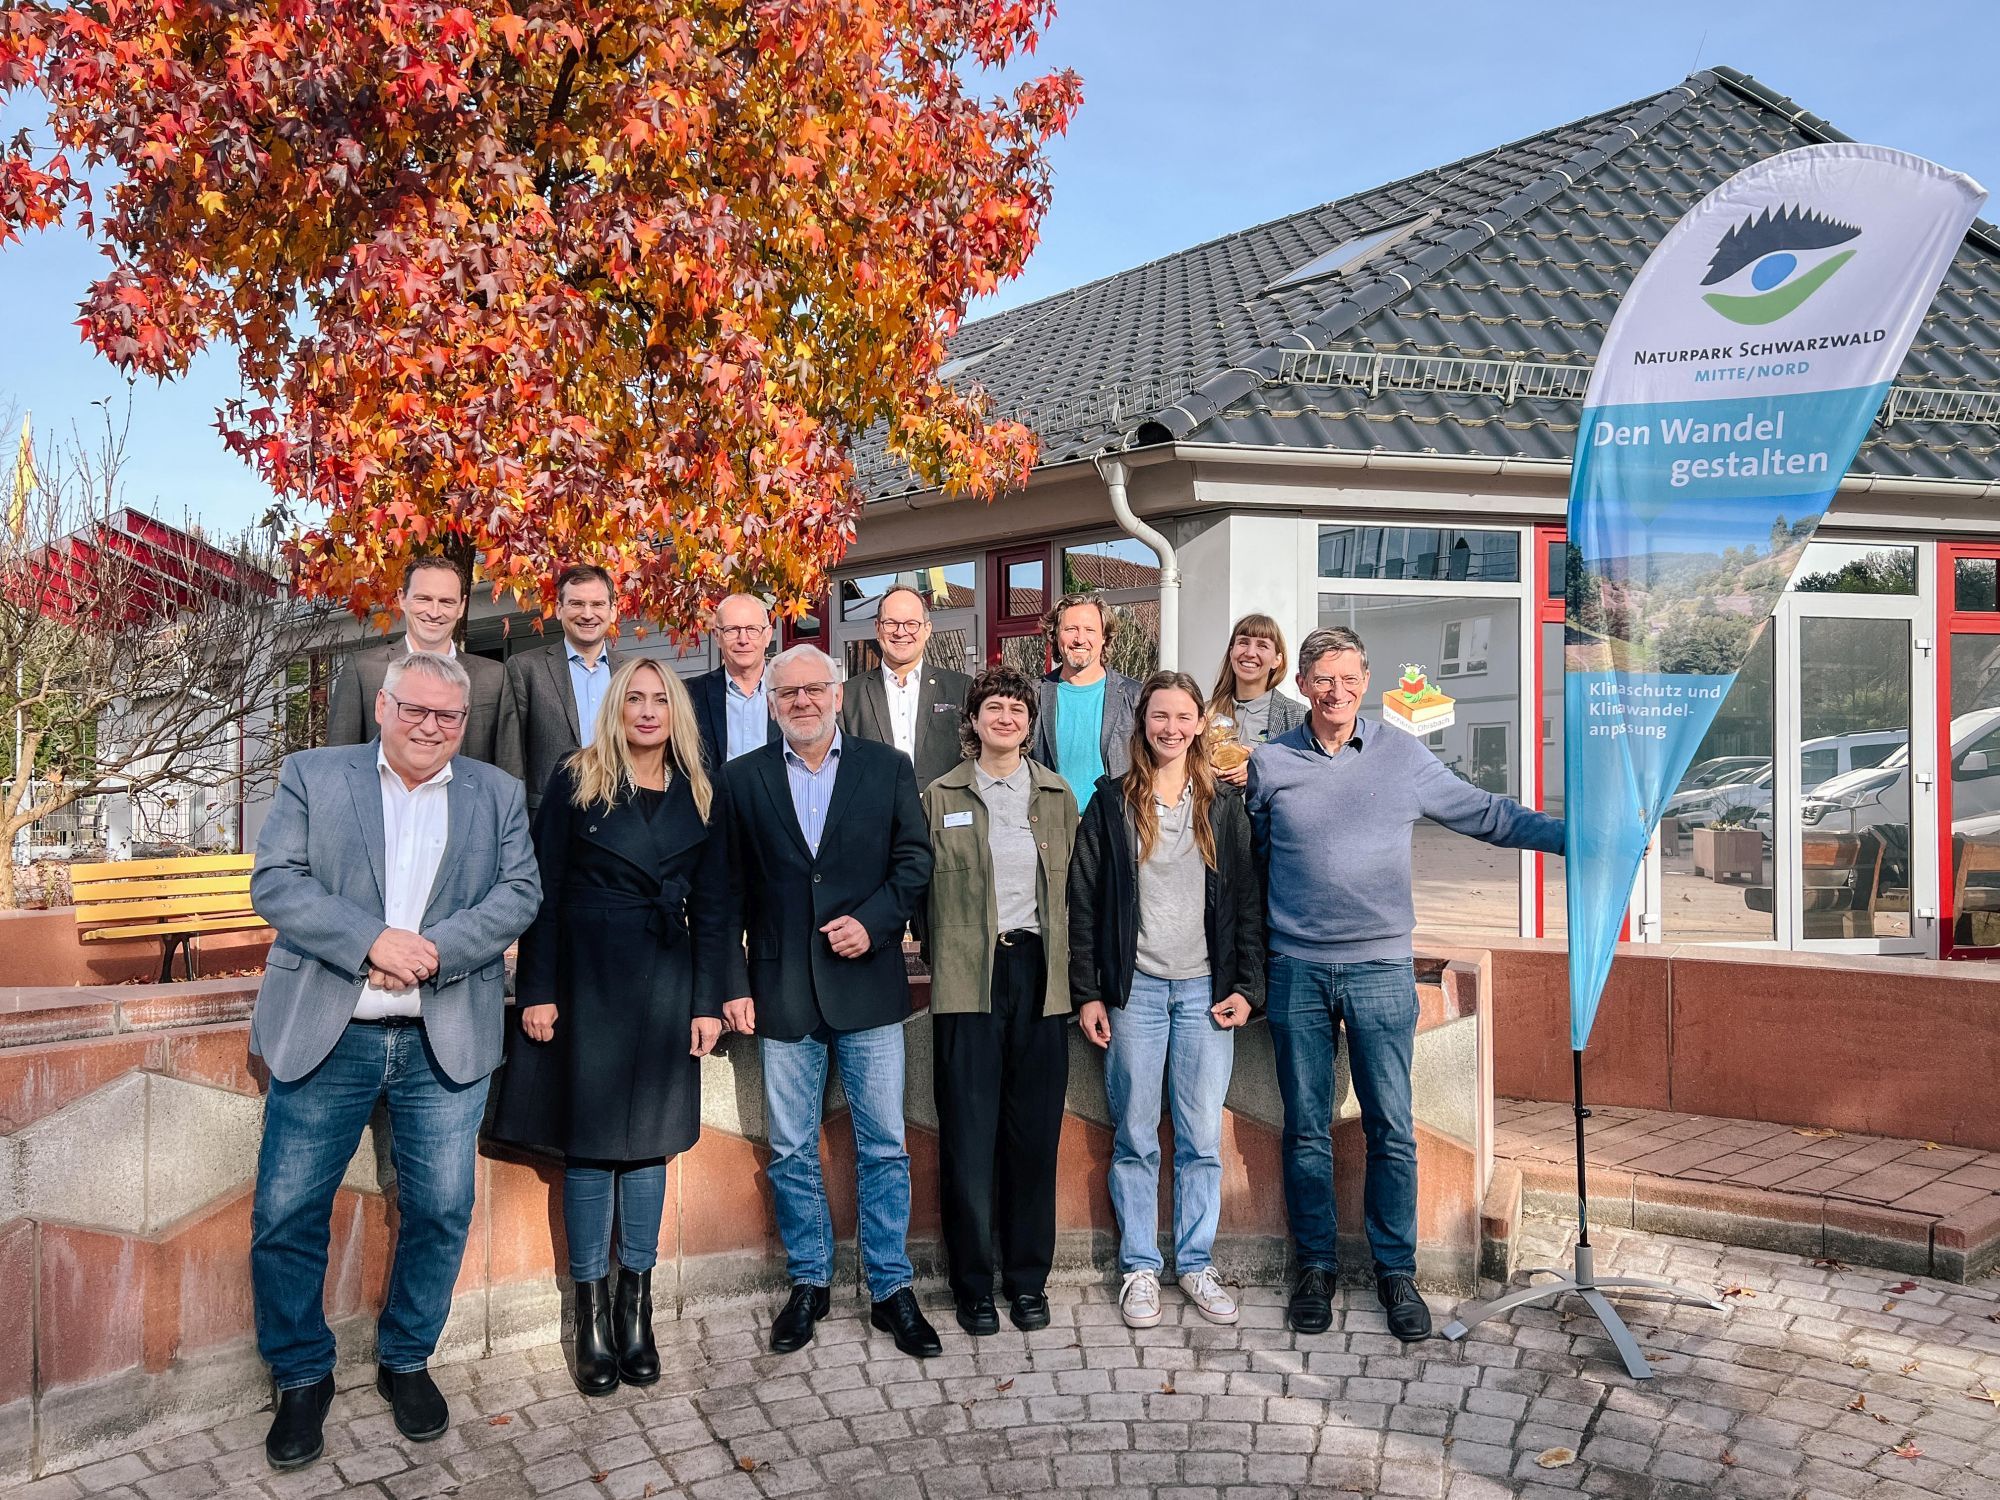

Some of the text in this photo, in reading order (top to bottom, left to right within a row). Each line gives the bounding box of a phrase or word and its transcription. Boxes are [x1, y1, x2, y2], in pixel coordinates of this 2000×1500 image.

[1634, 329, 1886, 365] NATURPARK SCHWARZWALD
[1694, 361, 1810, 382] MITTE/NORD
[1593, 411, 1784, 446] Den Wandel
[1670, 448, 1828, 487] gestalten
[1688, 684, 1721, 698] und
